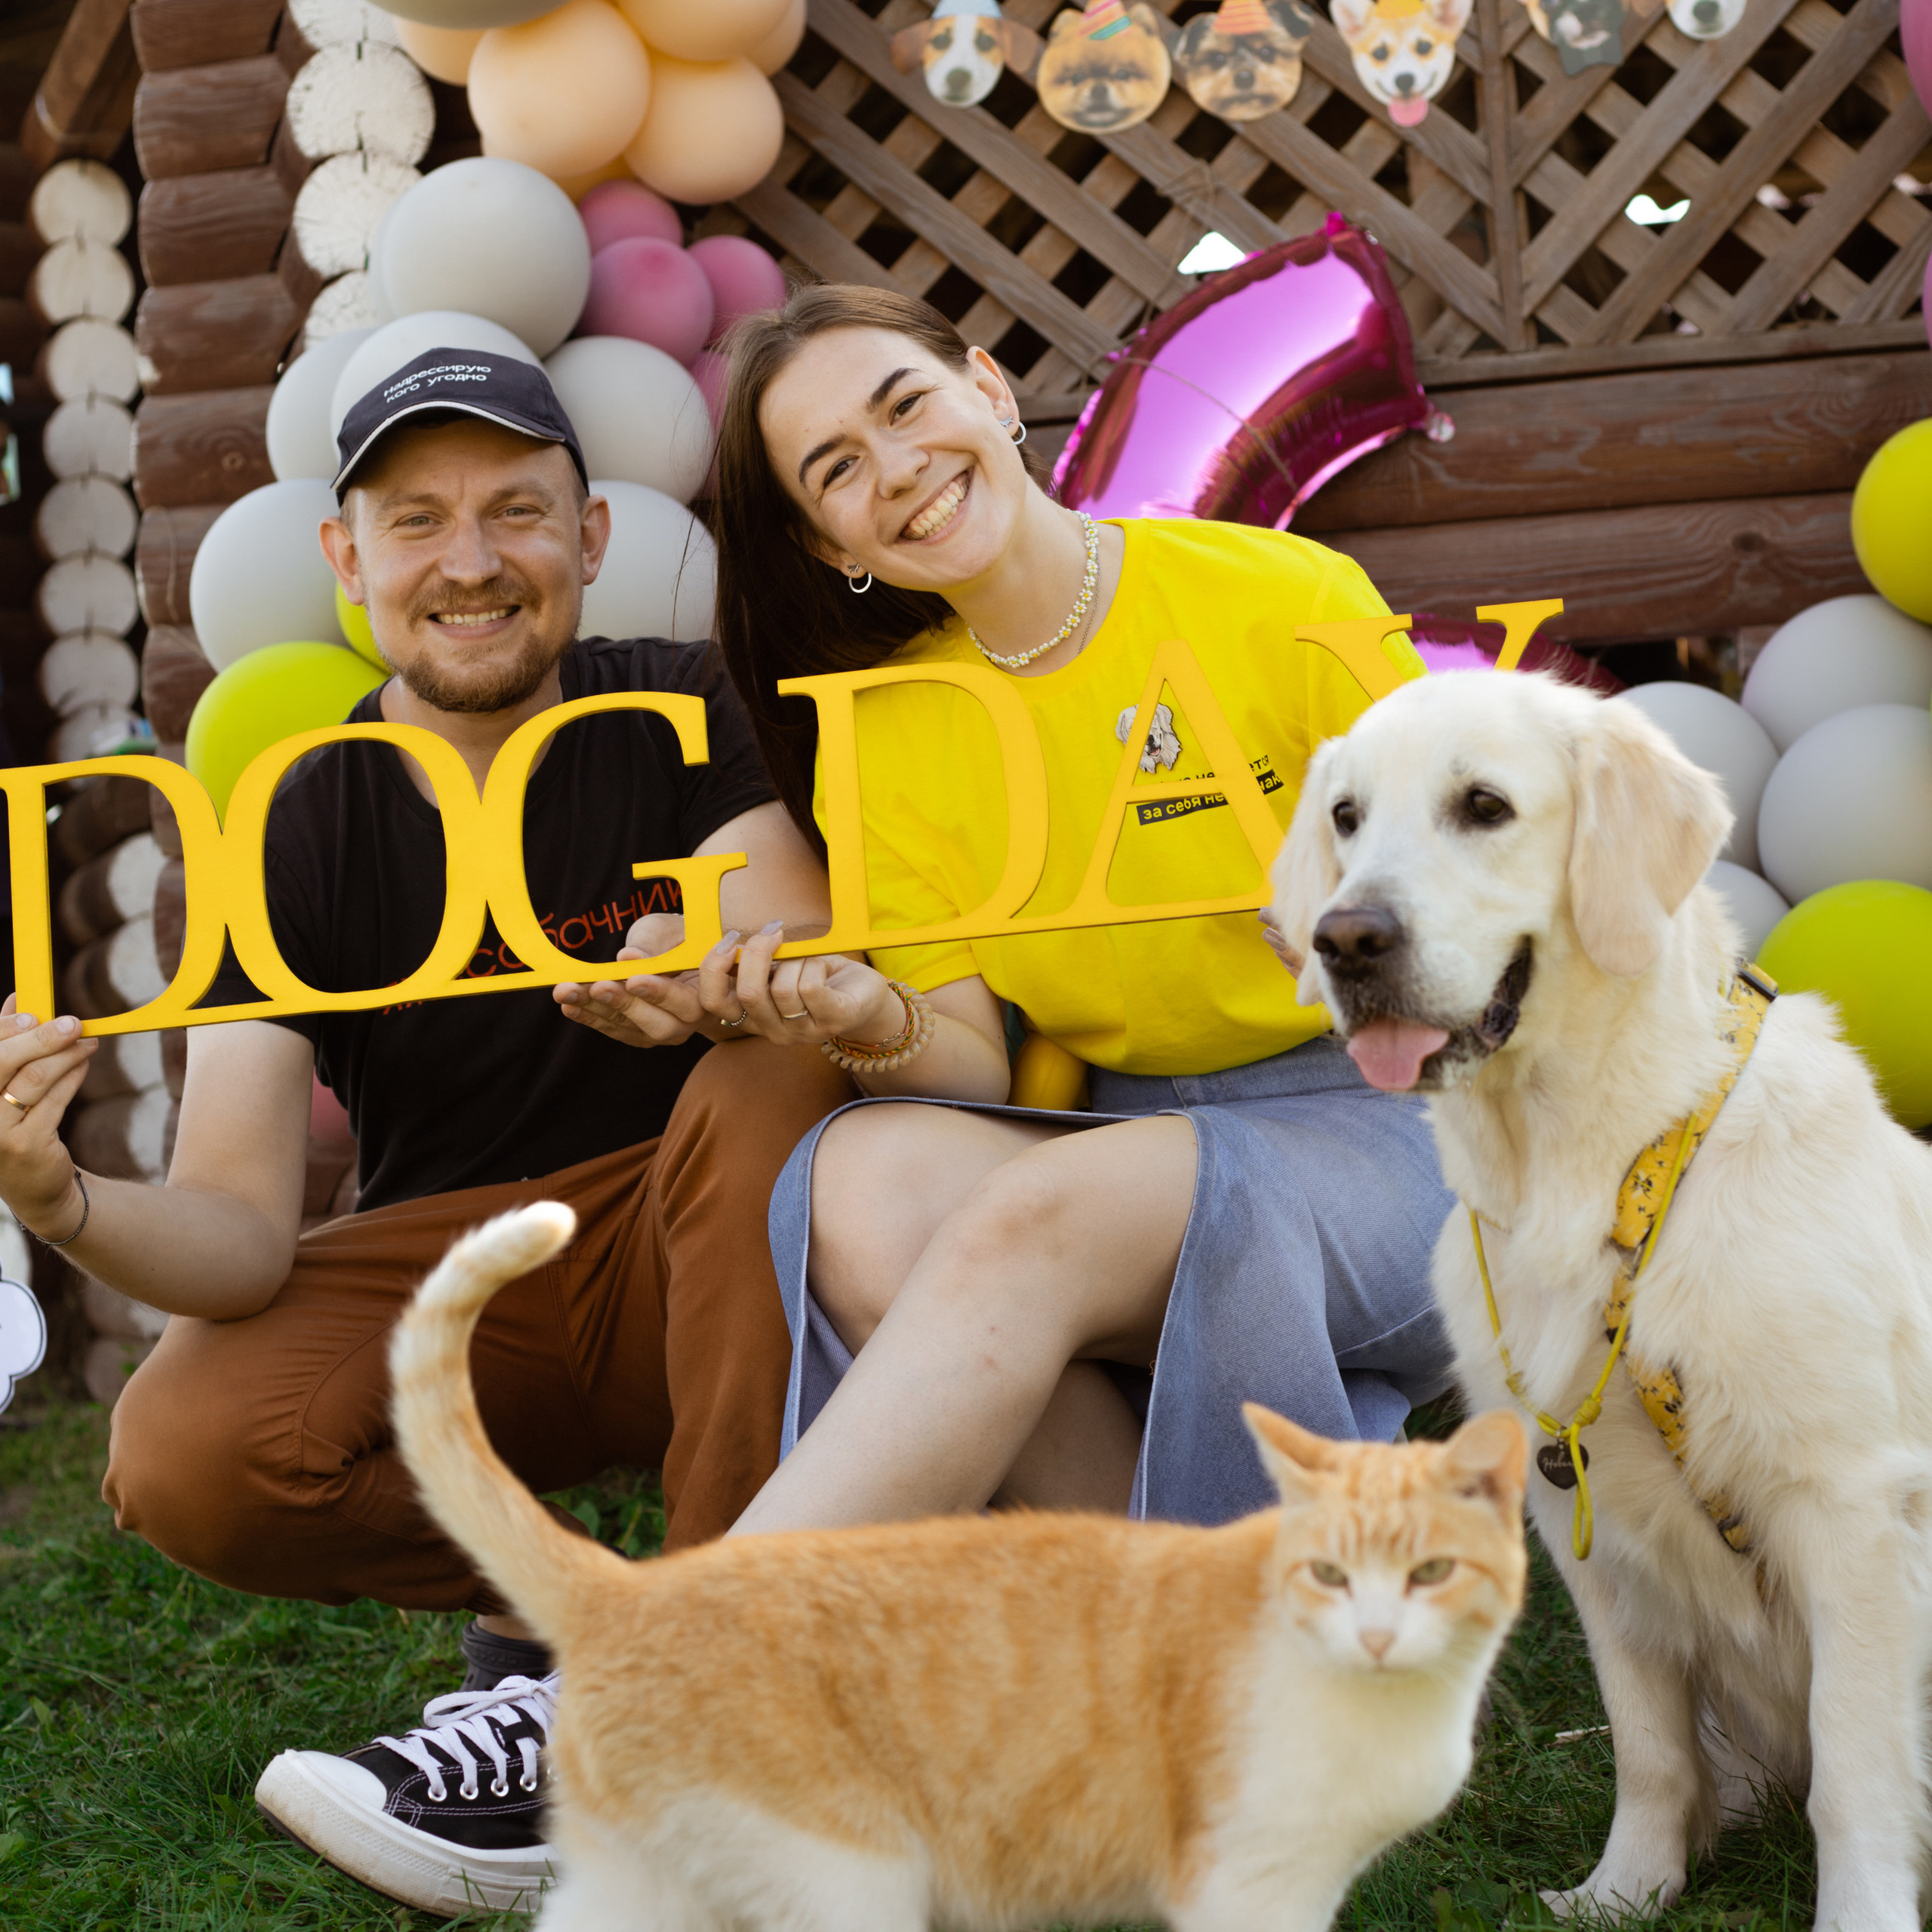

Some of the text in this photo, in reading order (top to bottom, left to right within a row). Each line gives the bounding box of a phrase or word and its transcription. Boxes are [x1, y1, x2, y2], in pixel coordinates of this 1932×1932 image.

[383, 365, 491, 397] надрессирую
[386, 374, 487, 403] кого угодно
[1143, 807, 1162, 820] за
[1166, 797, 1201, 814] себя
[0, 691, 748, 1037] DOG
